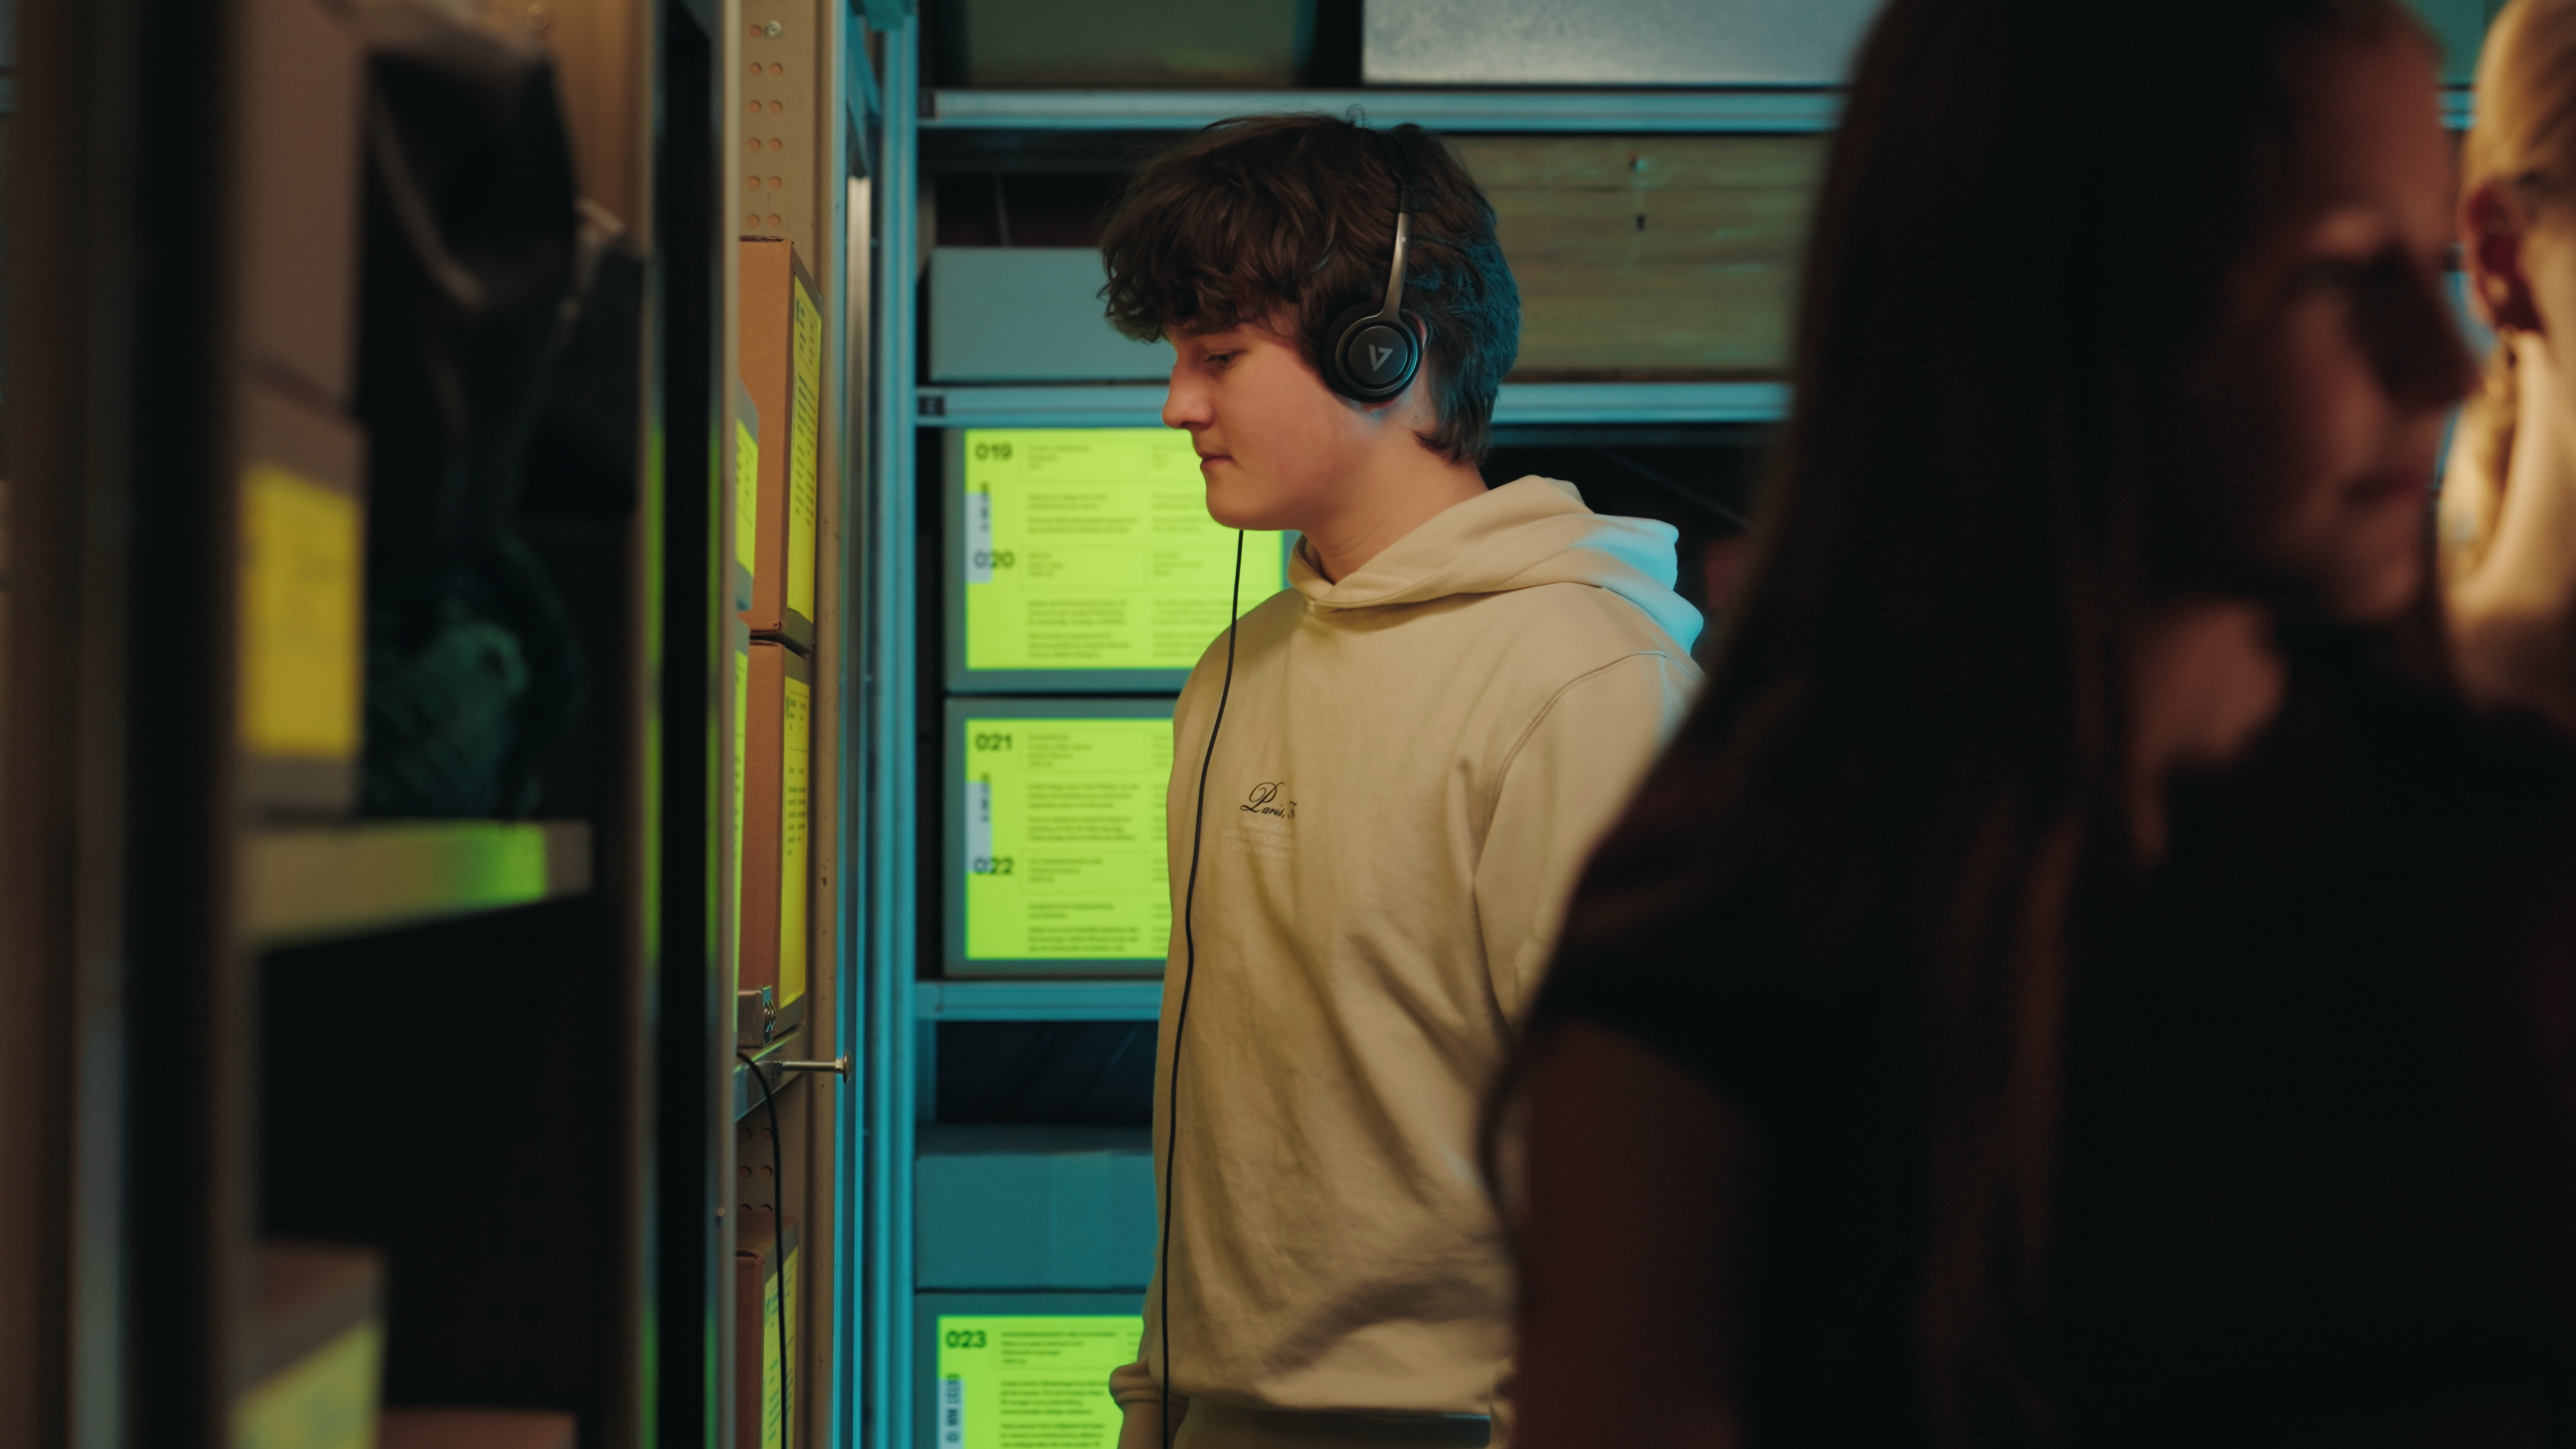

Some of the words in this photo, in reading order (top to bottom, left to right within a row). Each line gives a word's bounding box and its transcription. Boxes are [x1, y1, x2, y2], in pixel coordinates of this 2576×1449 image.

[975, 442, 1012, 462] 019
[973, 550, 1015, 570] 020
[975, 733, 1013, 751] 021
[1240, 782, 1285, 819] Paris,
[973, 857, 1014, 875] 022
[946, 1330, 987, 1348] 023
